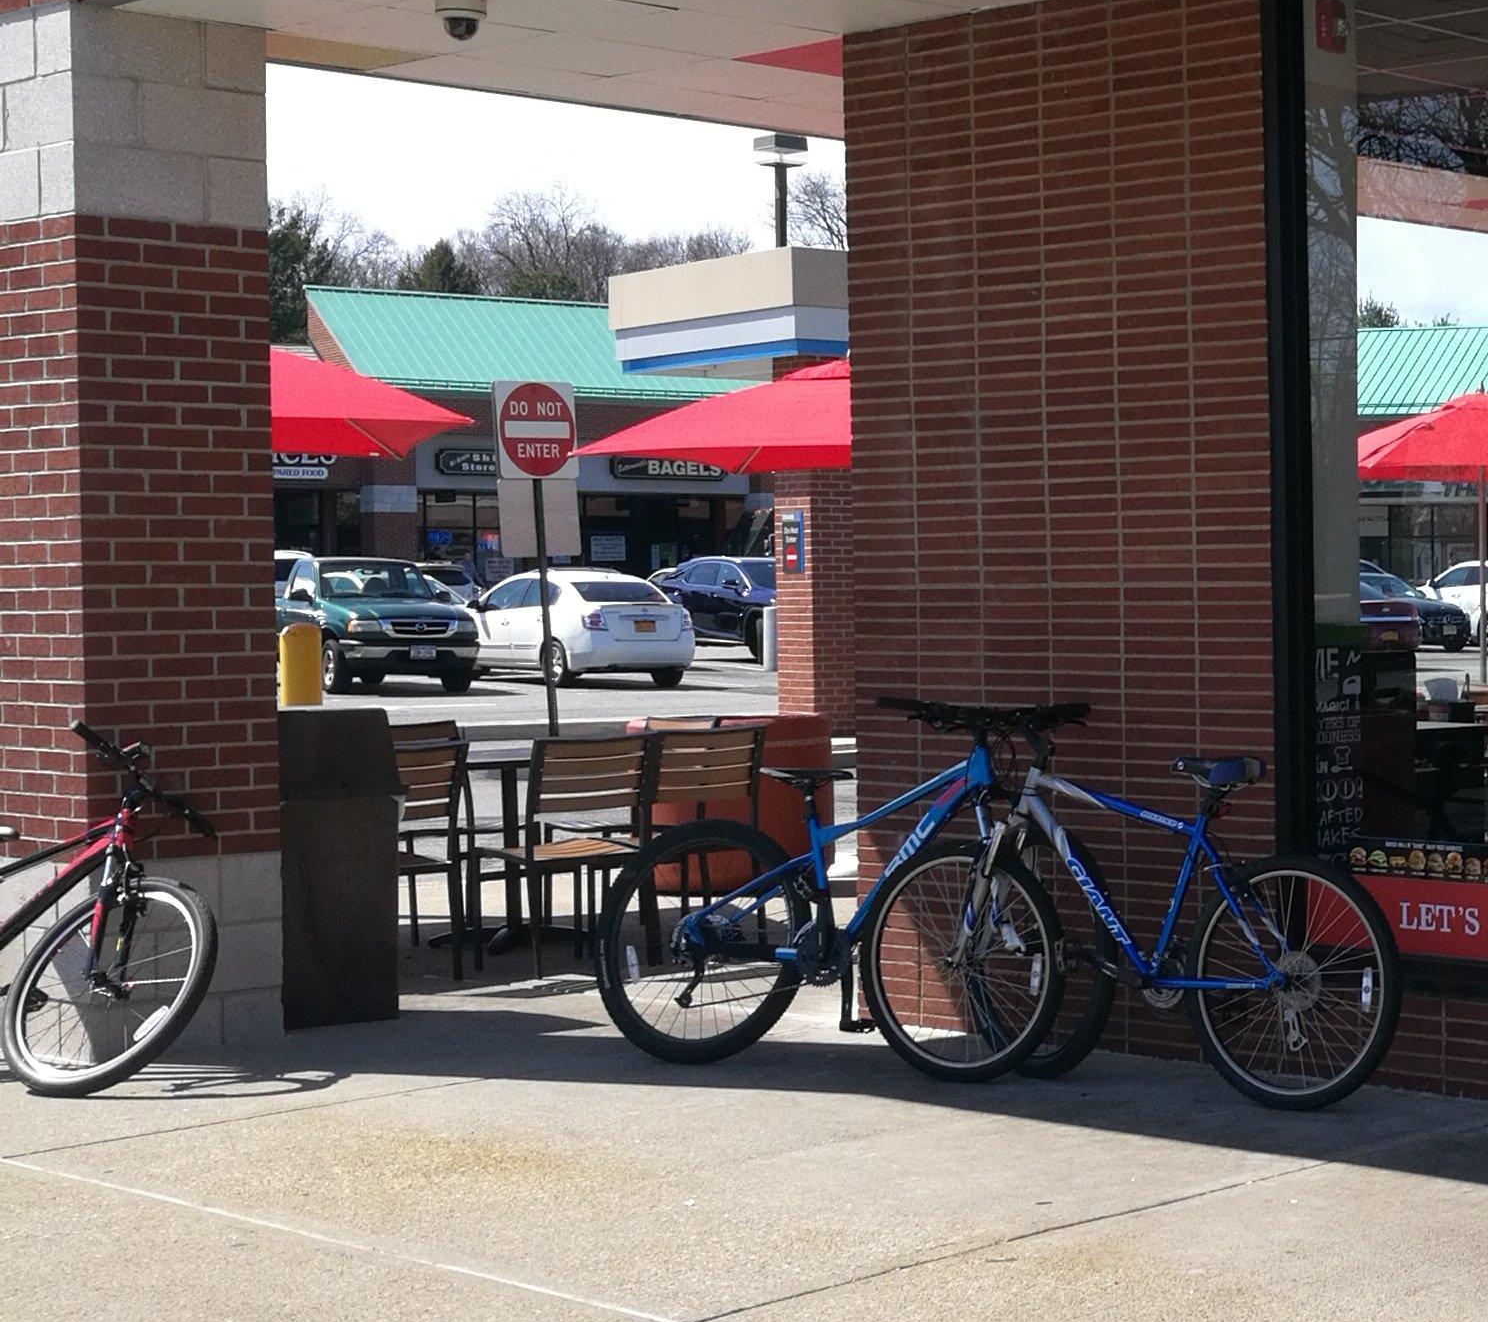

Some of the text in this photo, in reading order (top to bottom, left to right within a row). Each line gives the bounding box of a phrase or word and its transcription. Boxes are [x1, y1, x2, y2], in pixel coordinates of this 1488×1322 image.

[509, 400, 562, 416] DO NOT
[517, 443, 560, 458] ENTER
[648, 460, 722, 476] BAGELS
[1065, 857, 1132, 945] GIANT
[1399, 900, 1480, 937] LET'S
